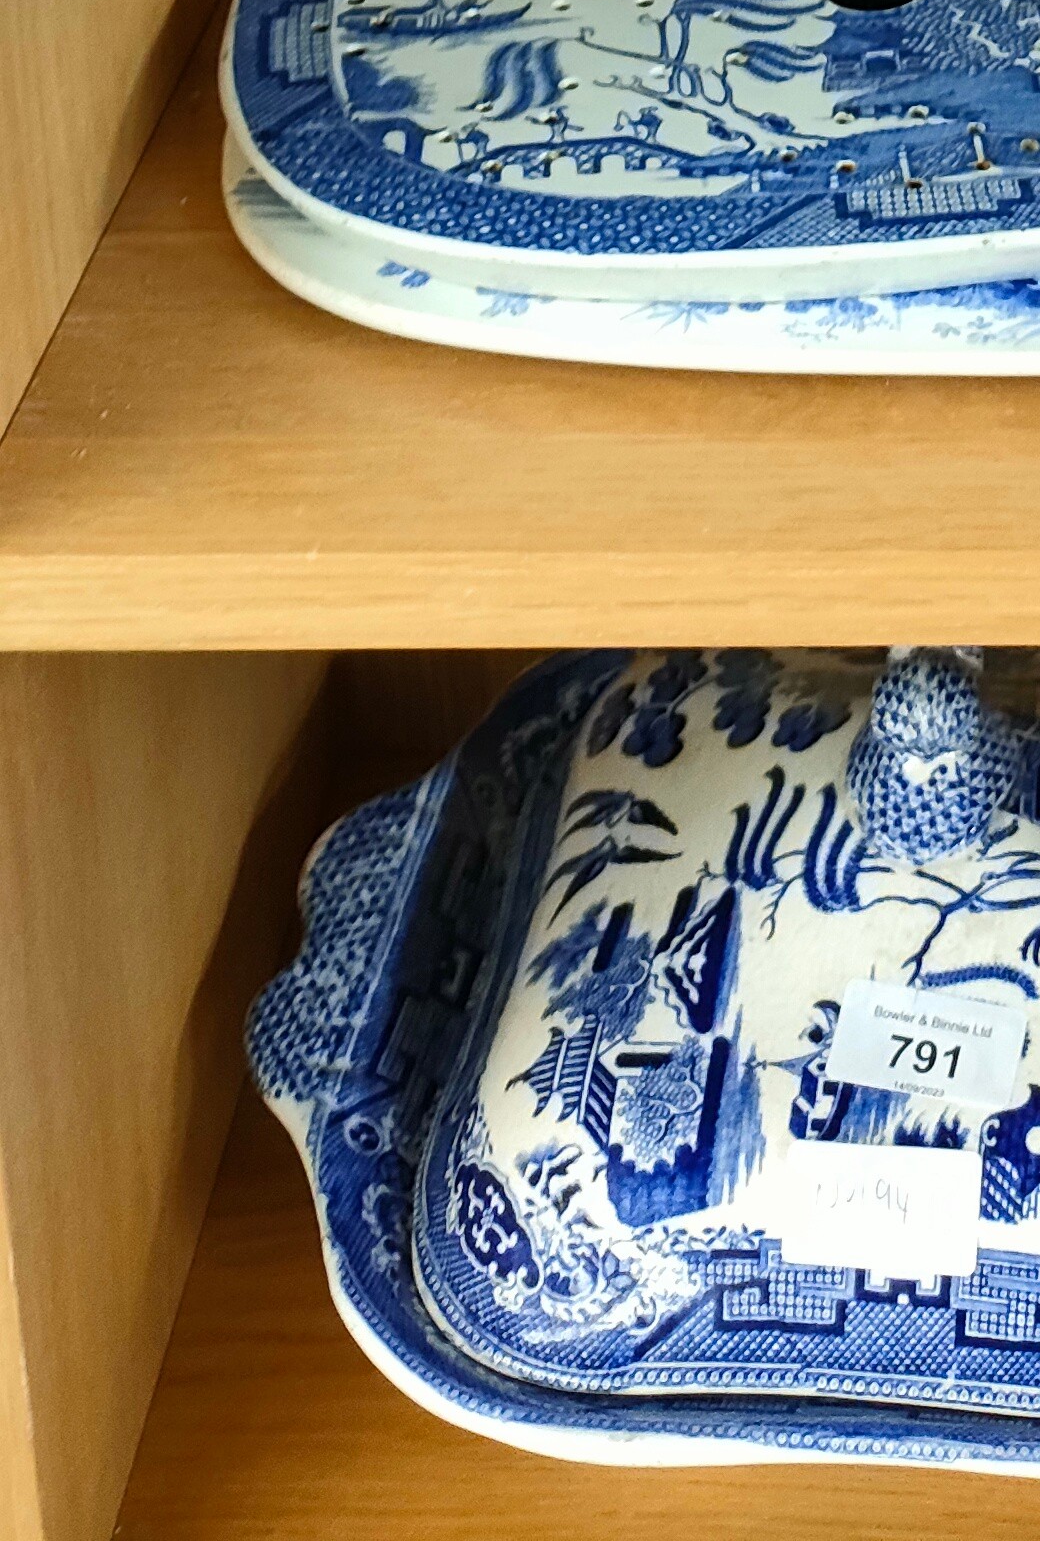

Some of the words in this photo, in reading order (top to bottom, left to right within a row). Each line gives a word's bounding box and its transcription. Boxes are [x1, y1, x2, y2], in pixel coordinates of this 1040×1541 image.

[874, 1004, 915, 1023] Bowler
[918, 1014, 928, 1026] &
[931, 1015, 970, 1034] Binnie
[972, 1023, 993, 1038] Ltd
[889, 1034, 961, 1078] 791
